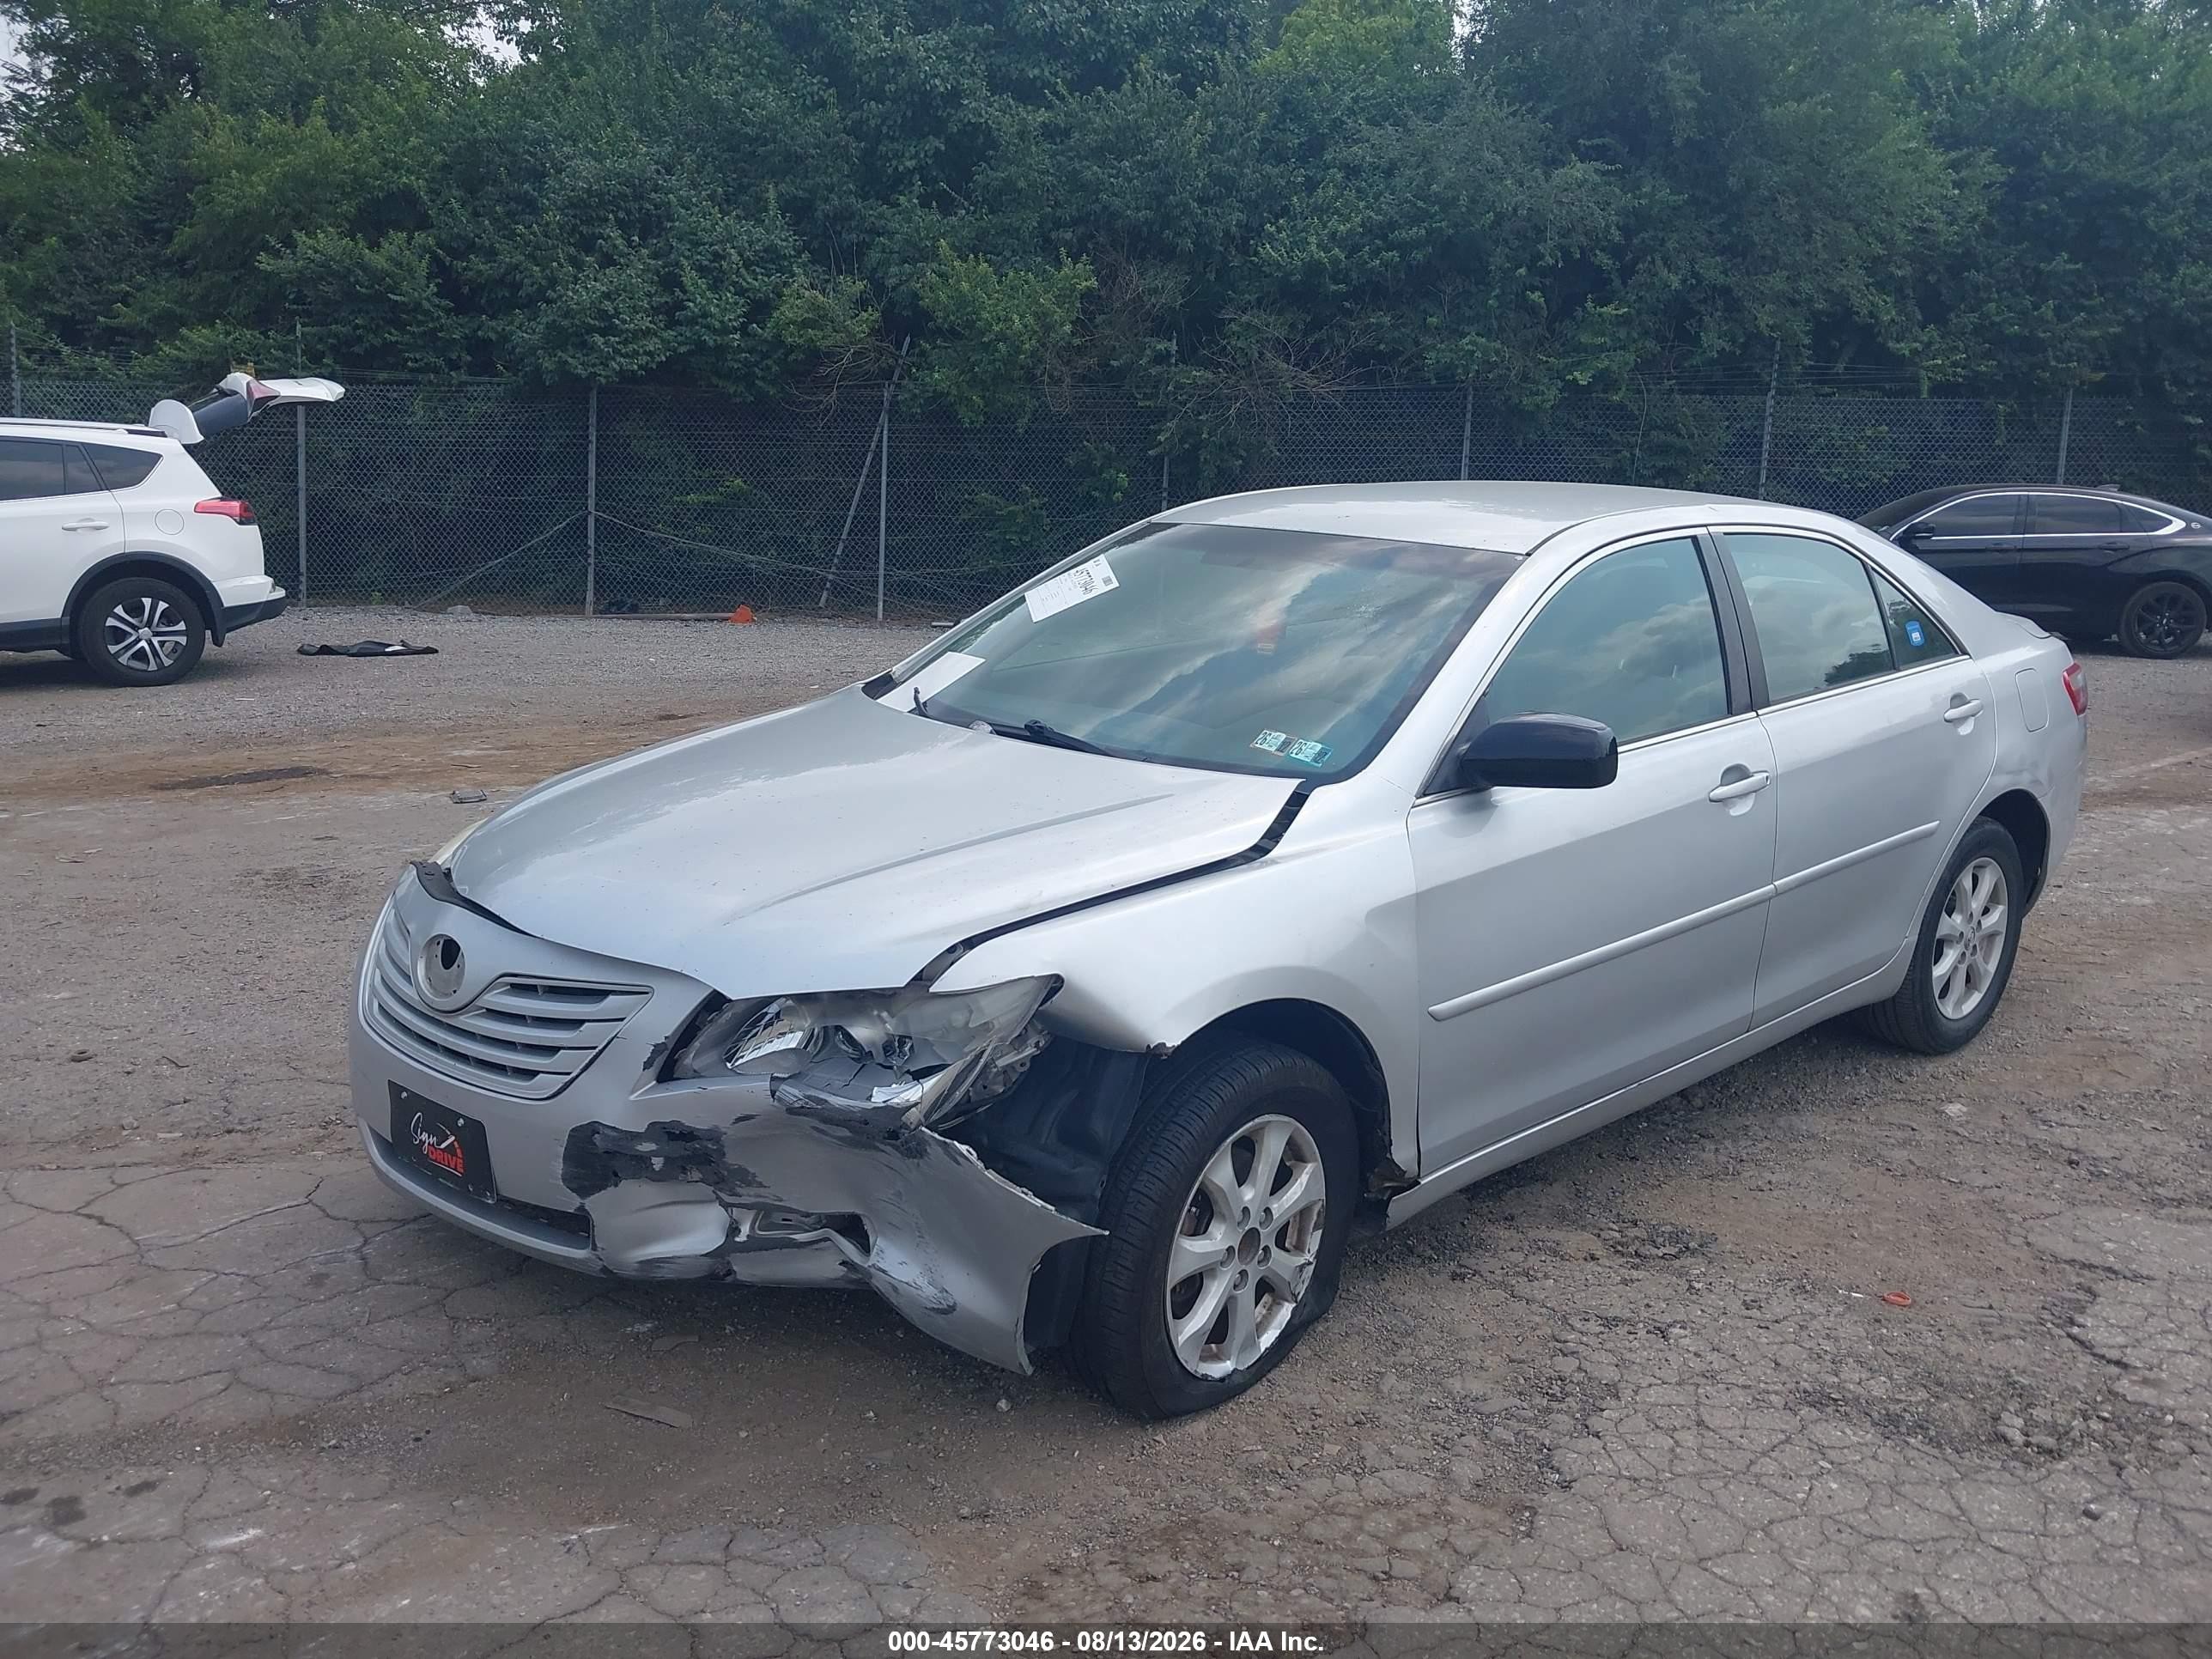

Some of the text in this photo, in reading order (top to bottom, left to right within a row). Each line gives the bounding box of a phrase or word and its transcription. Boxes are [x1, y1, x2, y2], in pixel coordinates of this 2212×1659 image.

[1255, 732, 1272, 745] 26
[1290, 741, 1307, 756] 26
[428, 1145, 465, 1174] DRIVE
